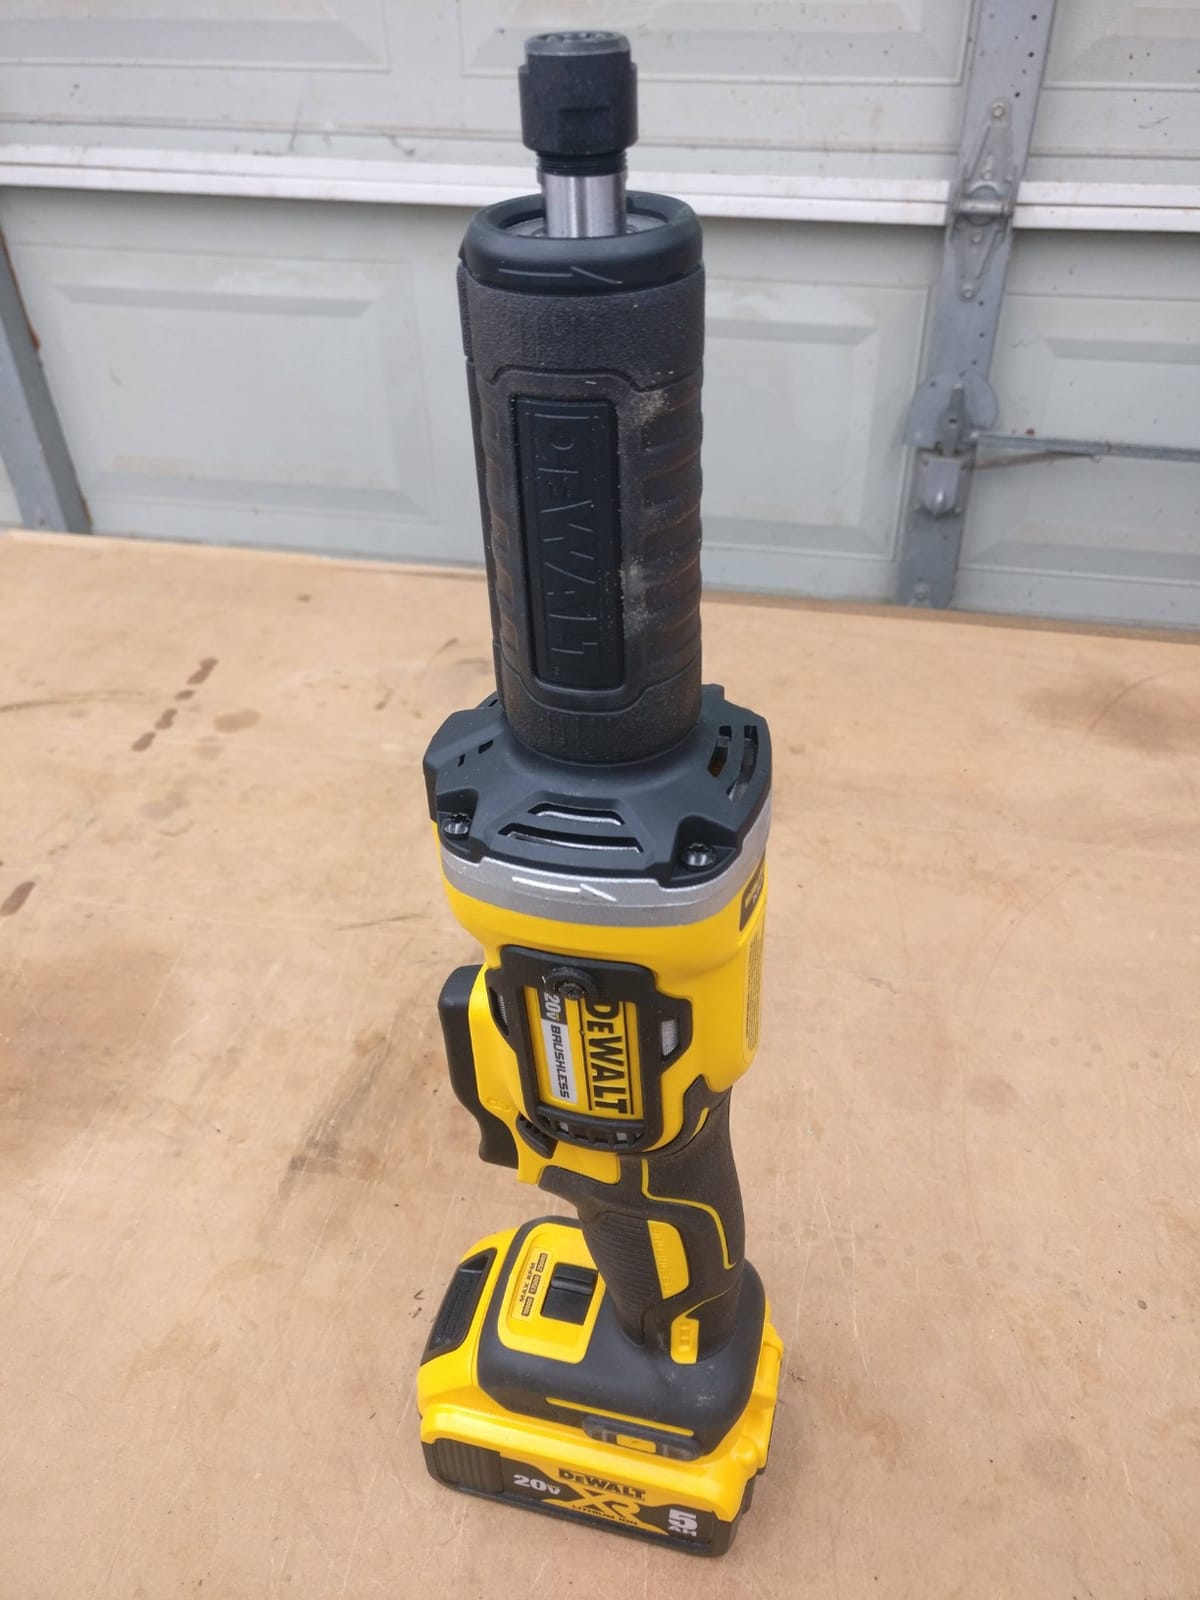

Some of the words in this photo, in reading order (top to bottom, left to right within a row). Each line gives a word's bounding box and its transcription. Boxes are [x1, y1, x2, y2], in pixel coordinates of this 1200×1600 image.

[550, 1024, 570, 1098] BRUSHLESS
[520, 1283, 529, 1302] MAX
[527, 1262, 536, 1280] RPM
[559, 1467, 646, 1500] DEWALT
[668, 1508, 698, 1531] 5
